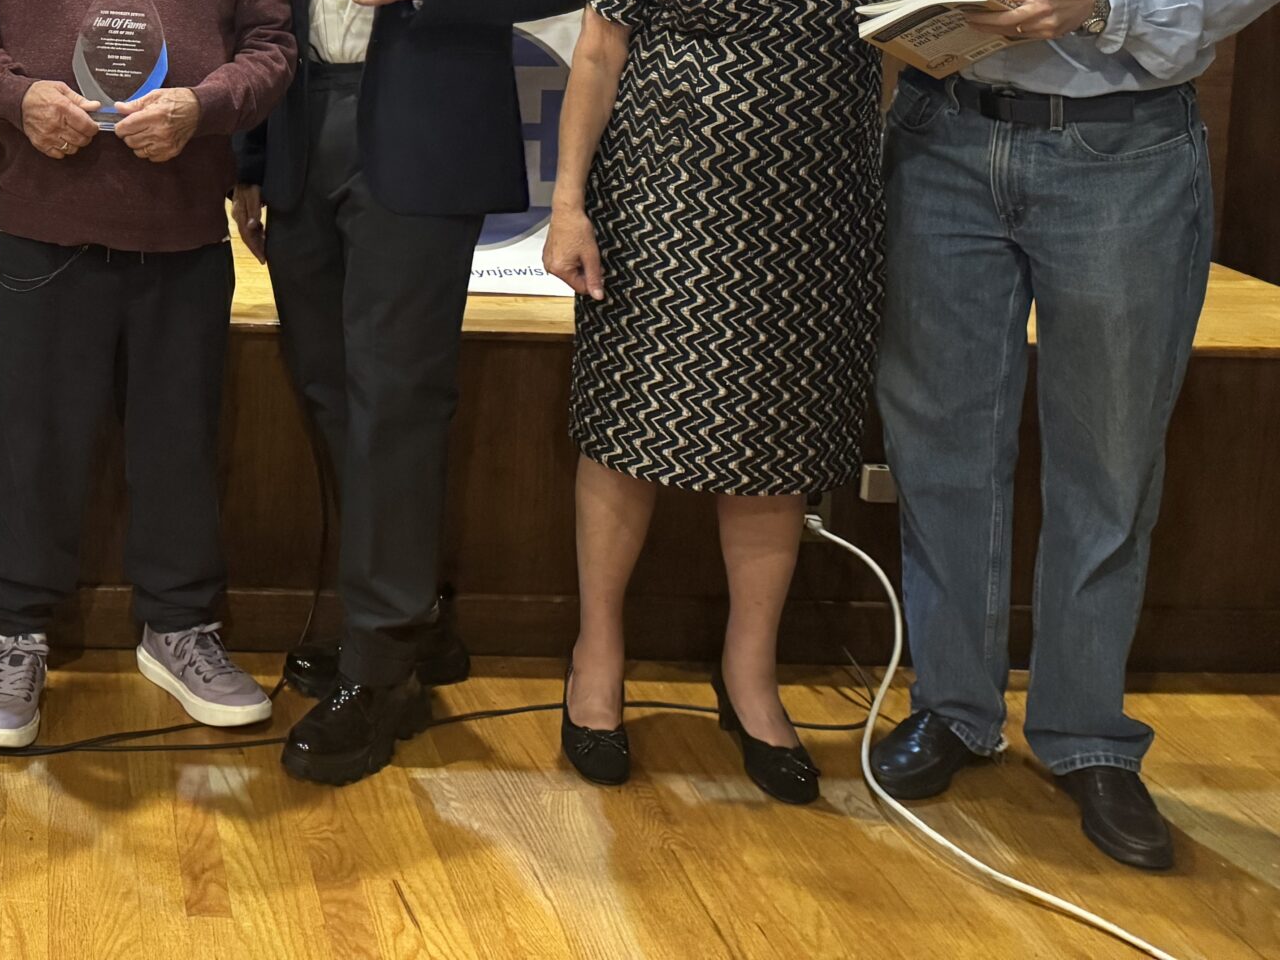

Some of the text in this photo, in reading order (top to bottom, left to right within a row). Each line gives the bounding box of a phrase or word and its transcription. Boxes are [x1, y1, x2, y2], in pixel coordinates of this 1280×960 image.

[93, 17, 147, 30] Hall Of Fame
